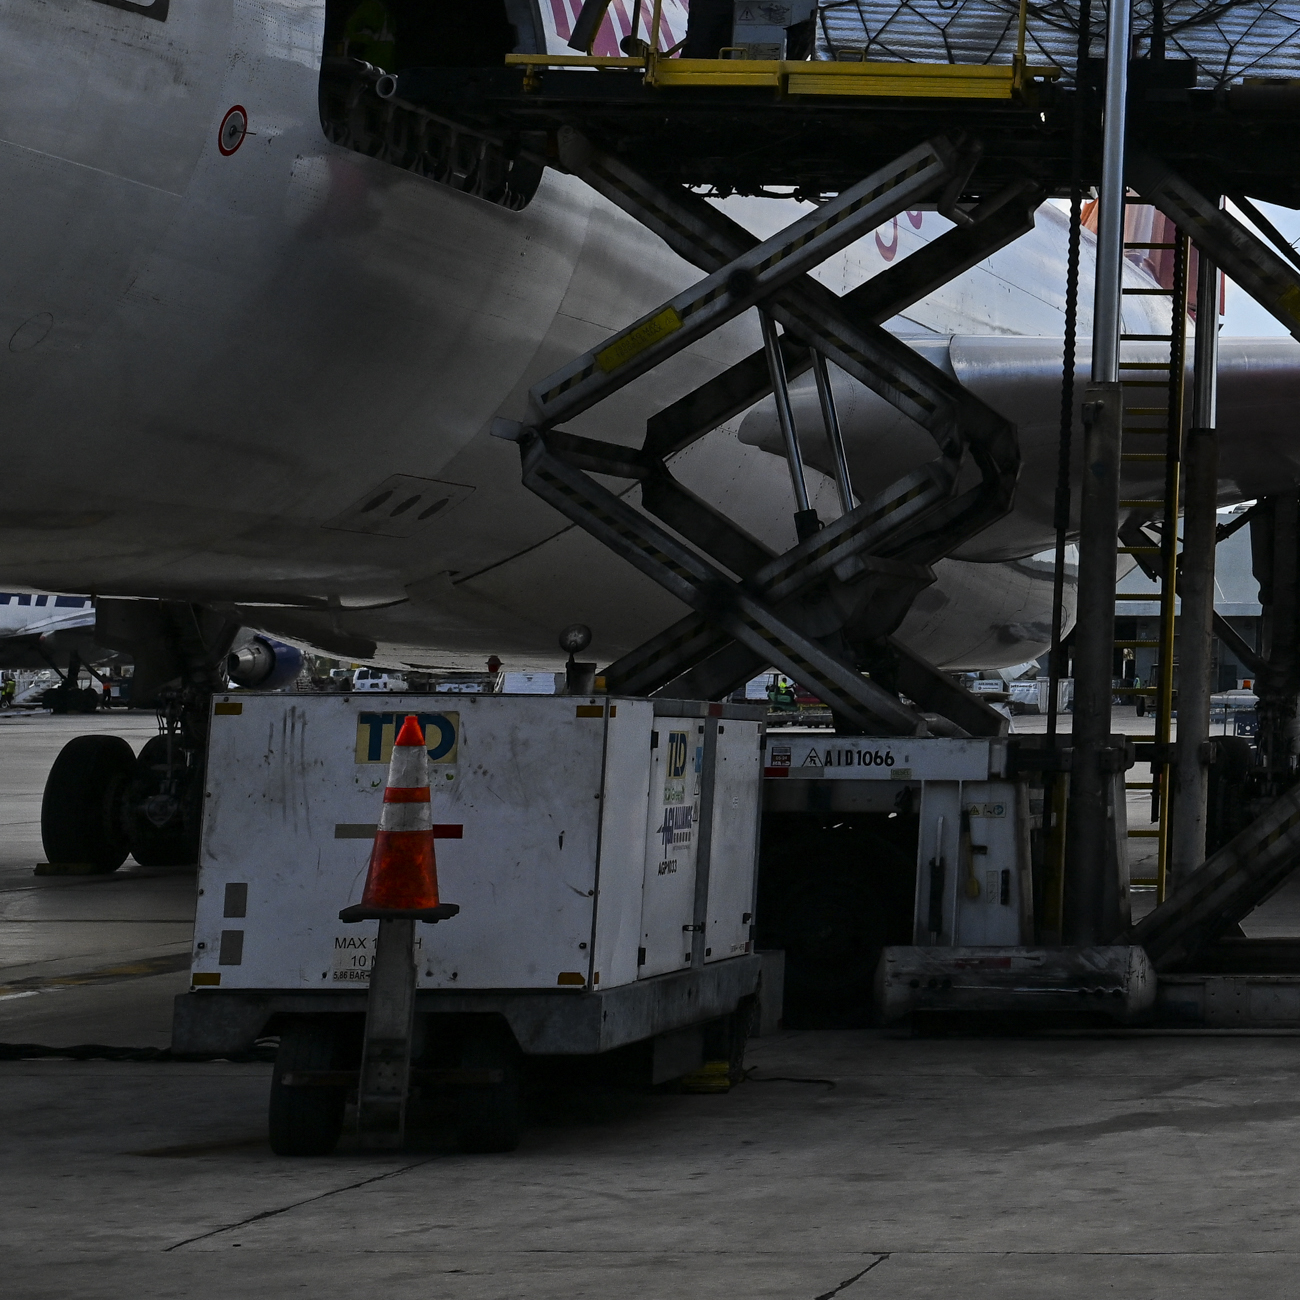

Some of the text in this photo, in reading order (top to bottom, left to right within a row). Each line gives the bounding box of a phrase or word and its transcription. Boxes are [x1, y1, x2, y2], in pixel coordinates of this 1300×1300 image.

[360, 713, 456, 761] TD
[668, 732, 687, 778] TLD
[335, 937, 367, 949] MAX
[351, 955, 366, 967] 10
